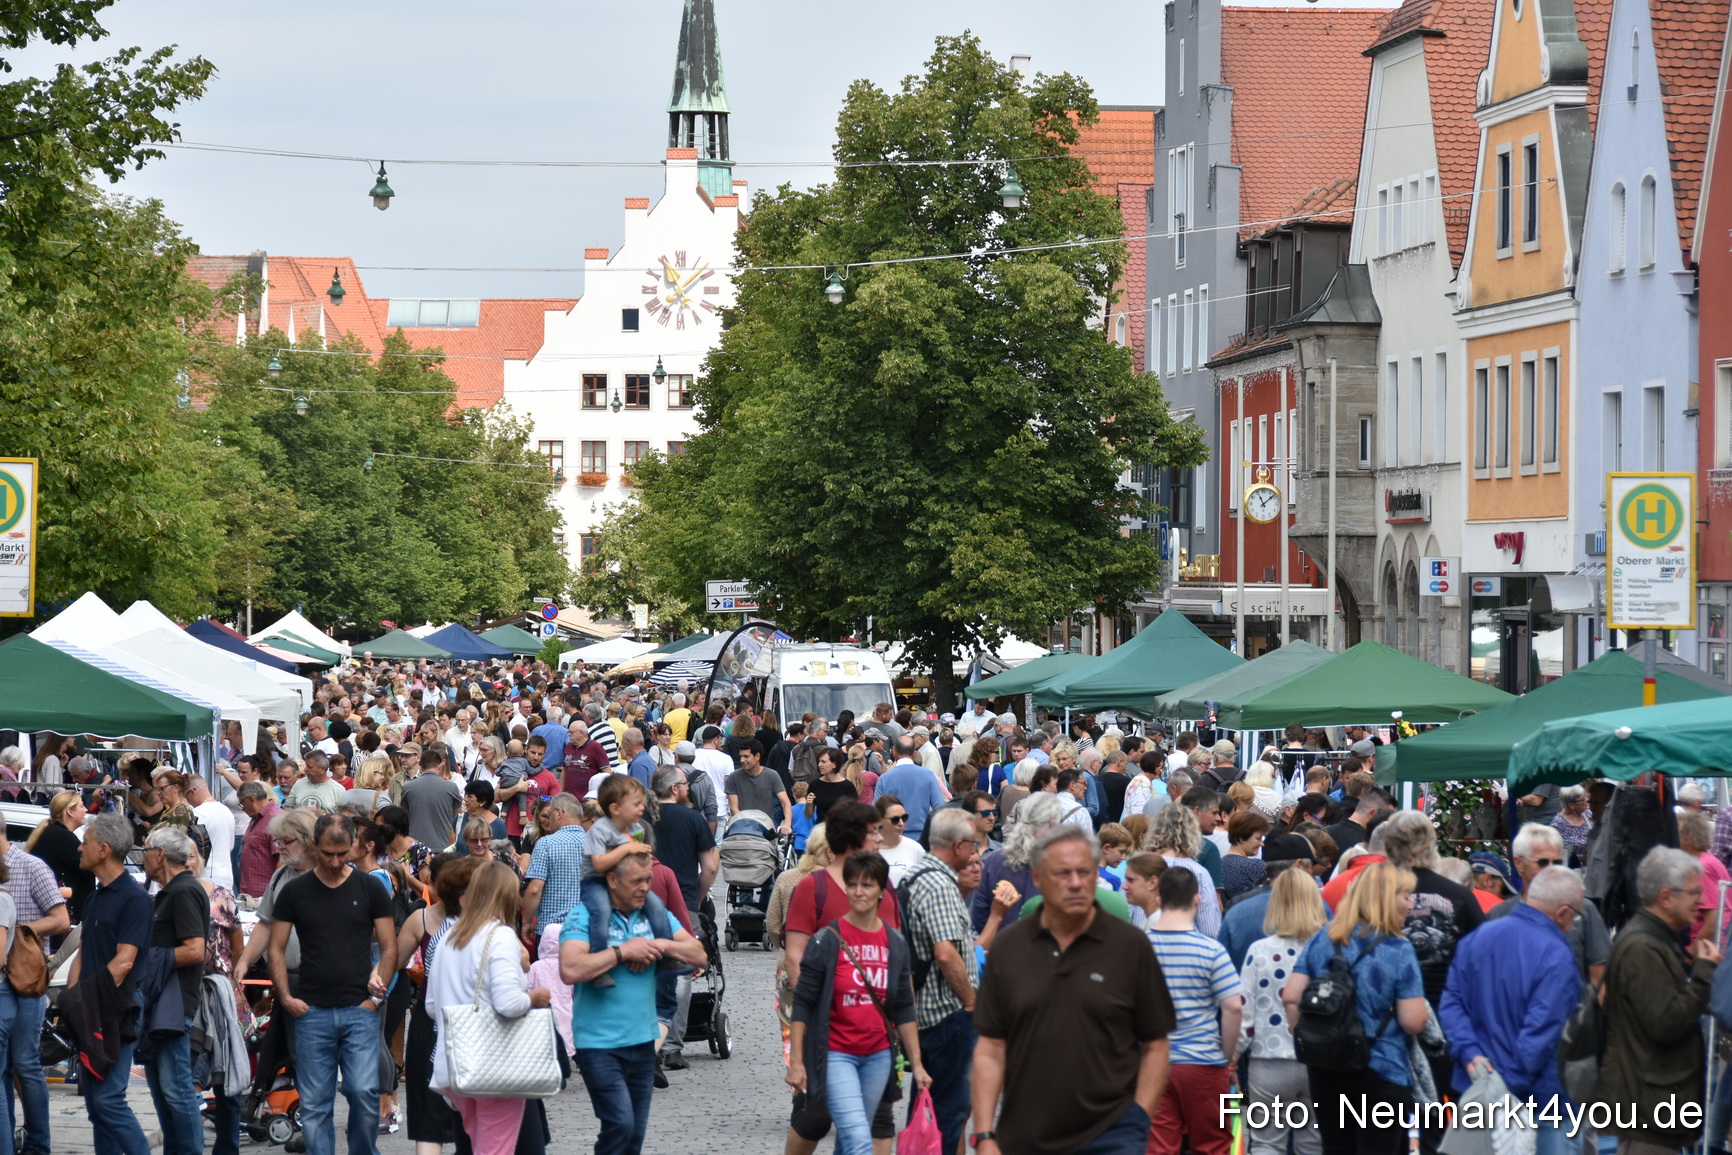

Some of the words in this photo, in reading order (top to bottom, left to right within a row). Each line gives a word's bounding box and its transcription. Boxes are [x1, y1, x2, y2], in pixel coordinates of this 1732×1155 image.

[1636, 499, 1666, 534] H
[1617, 556, 1652, 565] Oberer
[1656, 556, 1685, 565] Markt
[719, 584, 747, 593] Parkleit
[1251, 605, 1305, 613] SCHLRF
